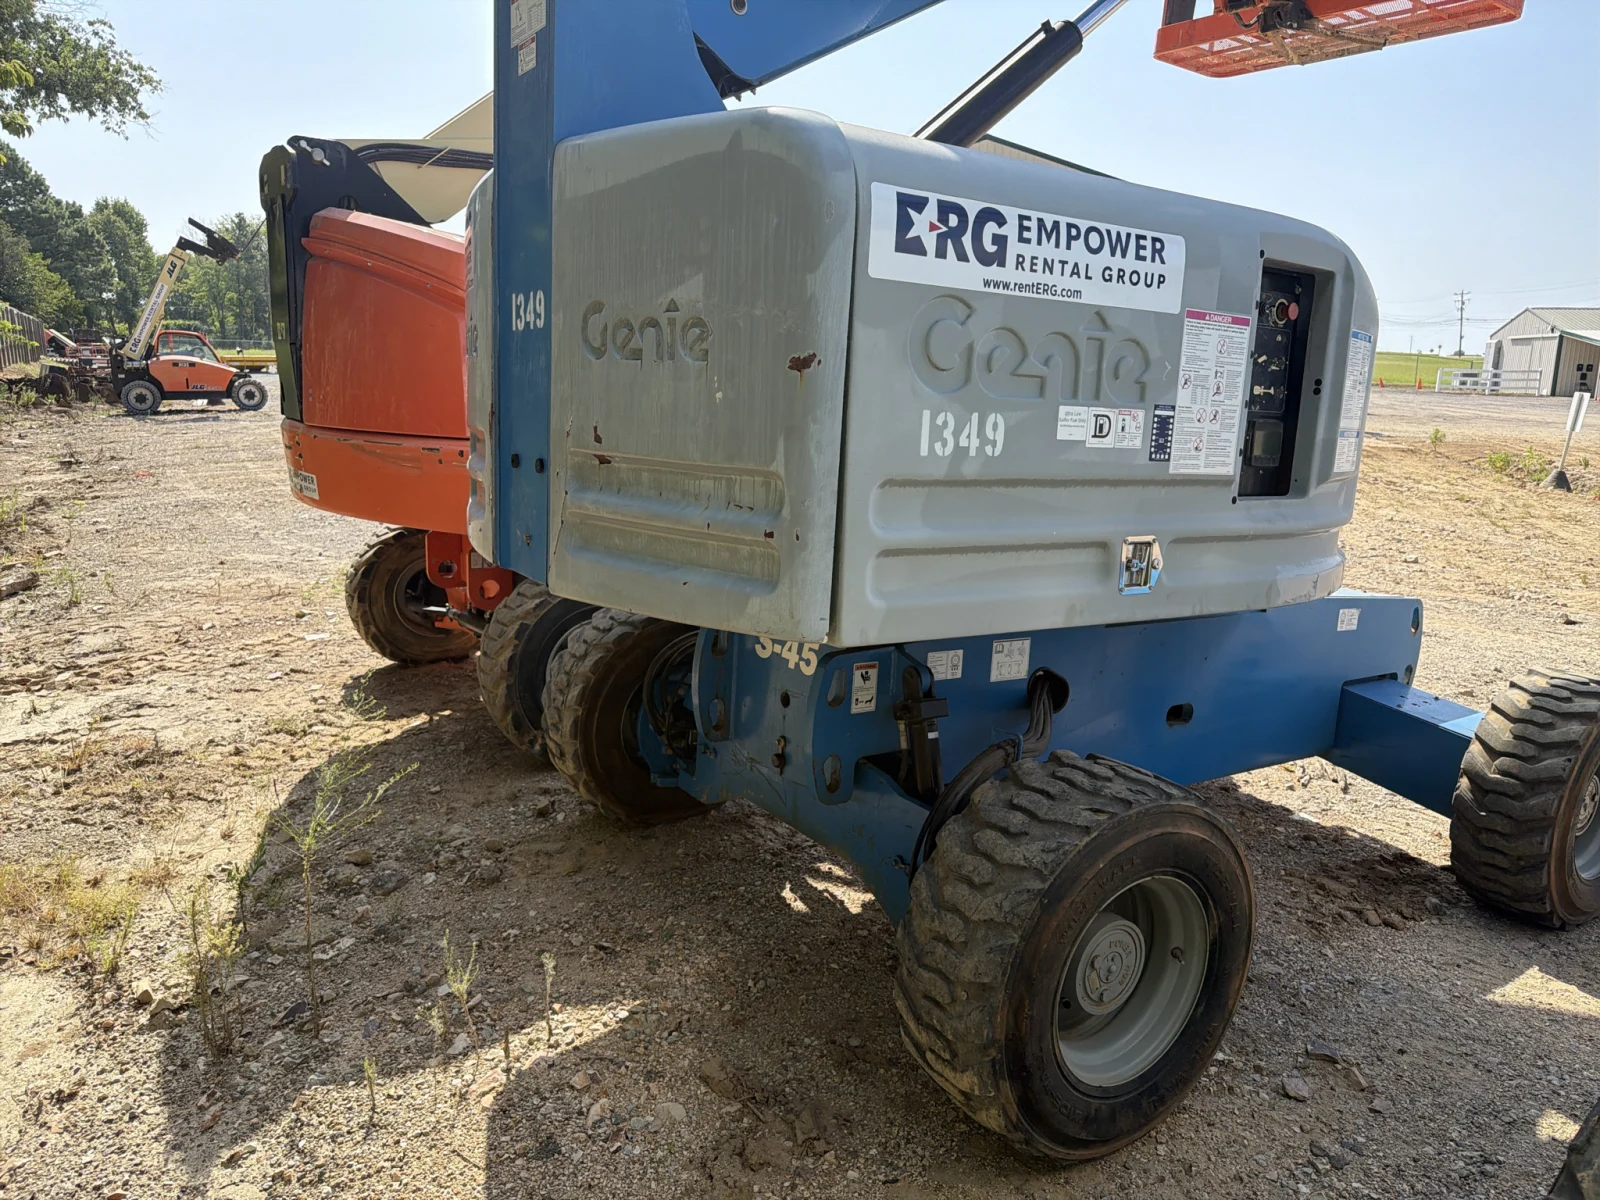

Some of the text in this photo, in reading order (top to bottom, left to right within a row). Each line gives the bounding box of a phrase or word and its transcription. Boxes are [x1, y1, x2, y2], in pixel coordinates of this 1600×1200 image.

[894, 190, 1009, 269] ERG
[1016, 213, 1167, 265] EMPOWER
[166, 260, 178, 279] JLG
[982, 277, 1083, 300] www.rentERG.com
[1015, 254, 1167, 290] RENTAL GROUP
[137, 315, 151, 339] EMPOWER
[147, 299, 159, 318] RENTAL
[156, 284, 165, 301] GROUP
[511, 290, 545, 331] 1349
[580, 297, 711, 361] Genie
[1210, 314, 1233, 323] DANGER
[907, 293, 1151, 404] Genie
[919, 409, 1005, 457] 1349
[1091, 413, 1112, 439] D
